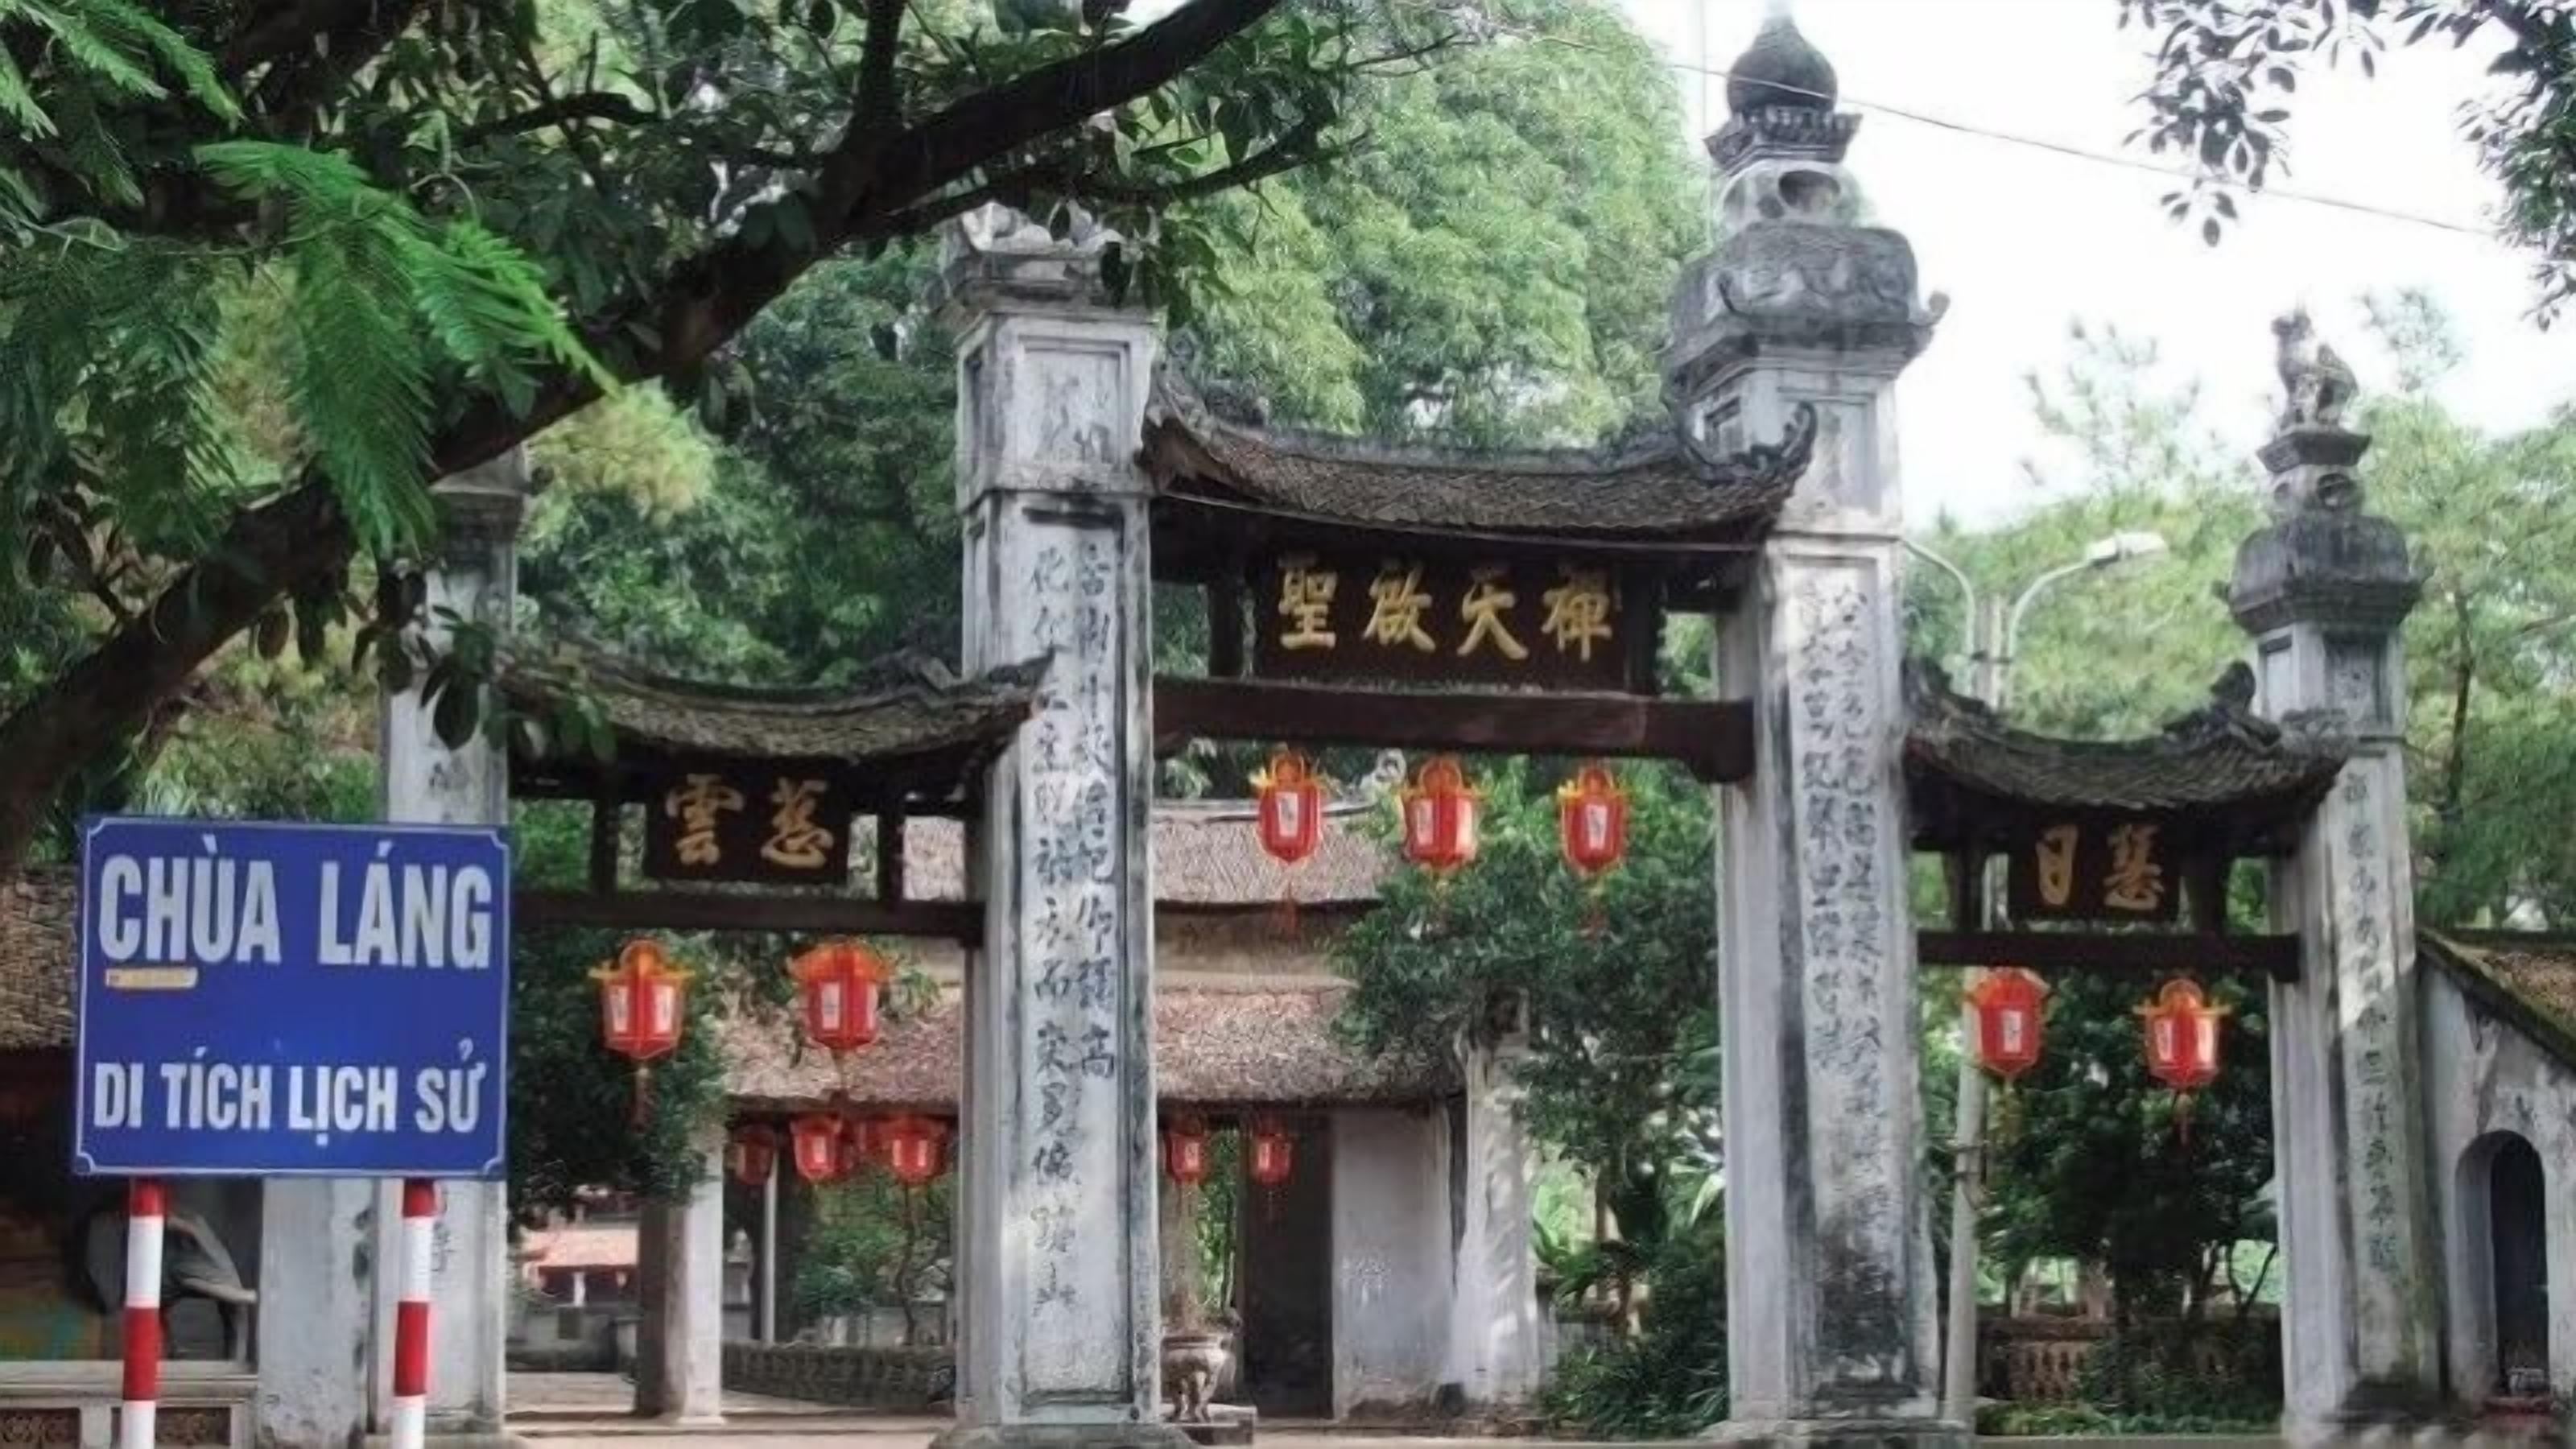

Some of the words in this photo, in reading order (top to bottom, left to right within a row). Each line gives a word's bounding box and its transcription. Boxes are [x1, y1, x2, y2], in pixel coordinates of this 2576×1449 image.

[98, 835, 282, 963] CHÙA
[318, 840, 493, 968] LÁNG
[93, 1063, 145, 1128] DI
[161, 1046, 272, 1129] TÍCH
[288, 1065, 398, 1146] LỊCH
[415, 1038, 487, 1133] SỬ
